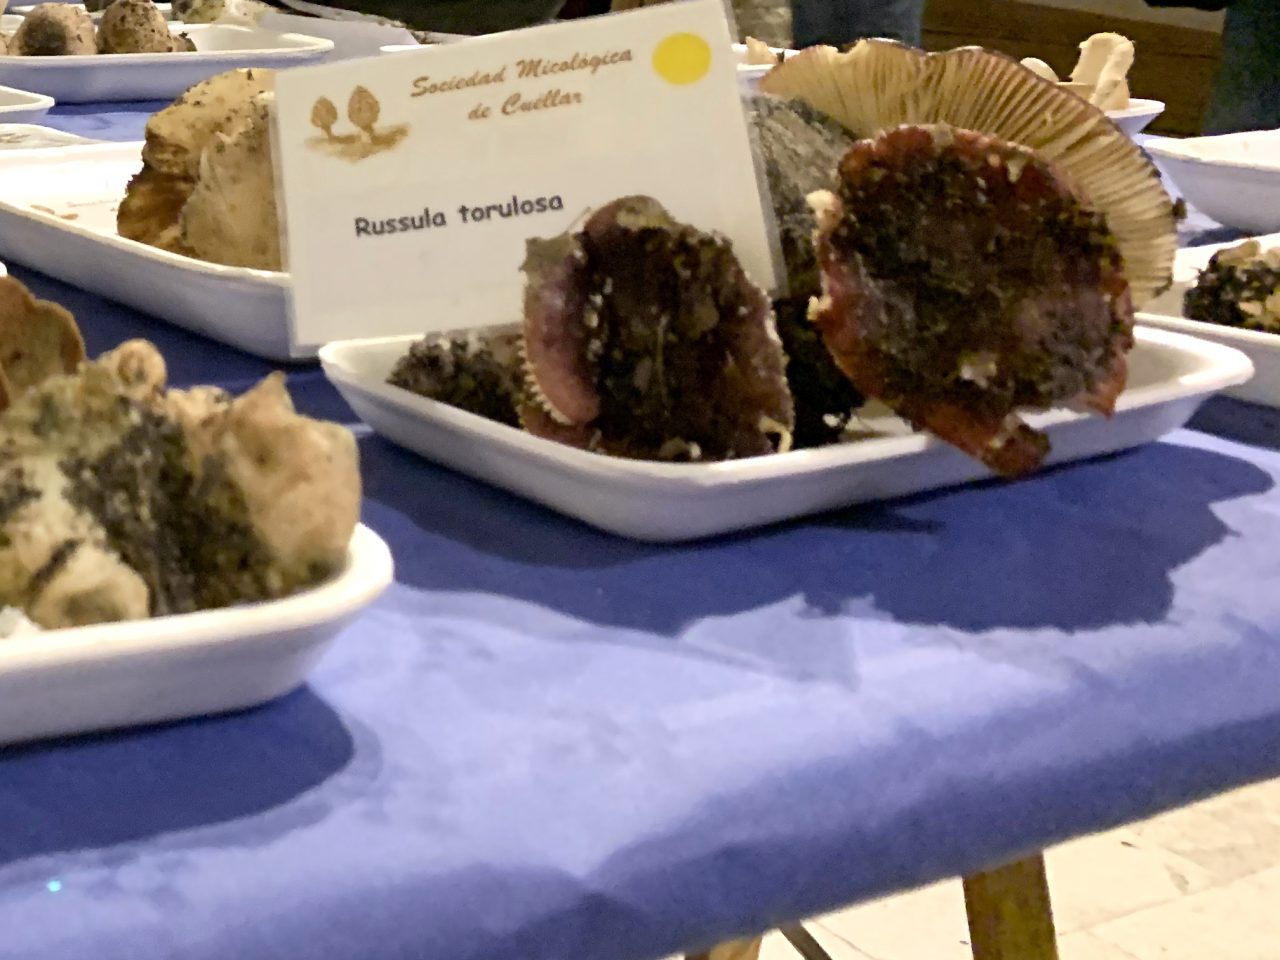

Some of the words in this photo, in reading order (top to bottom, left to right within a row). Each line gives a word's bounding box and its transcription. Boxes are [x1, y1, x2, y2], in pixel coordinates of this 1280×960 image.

[410, 65, 507, 97] Sociedad
[468, 102, 491, 120] de
[354, 207, 447, 237] Russula
[458, 195, 564, 224] torulosa
